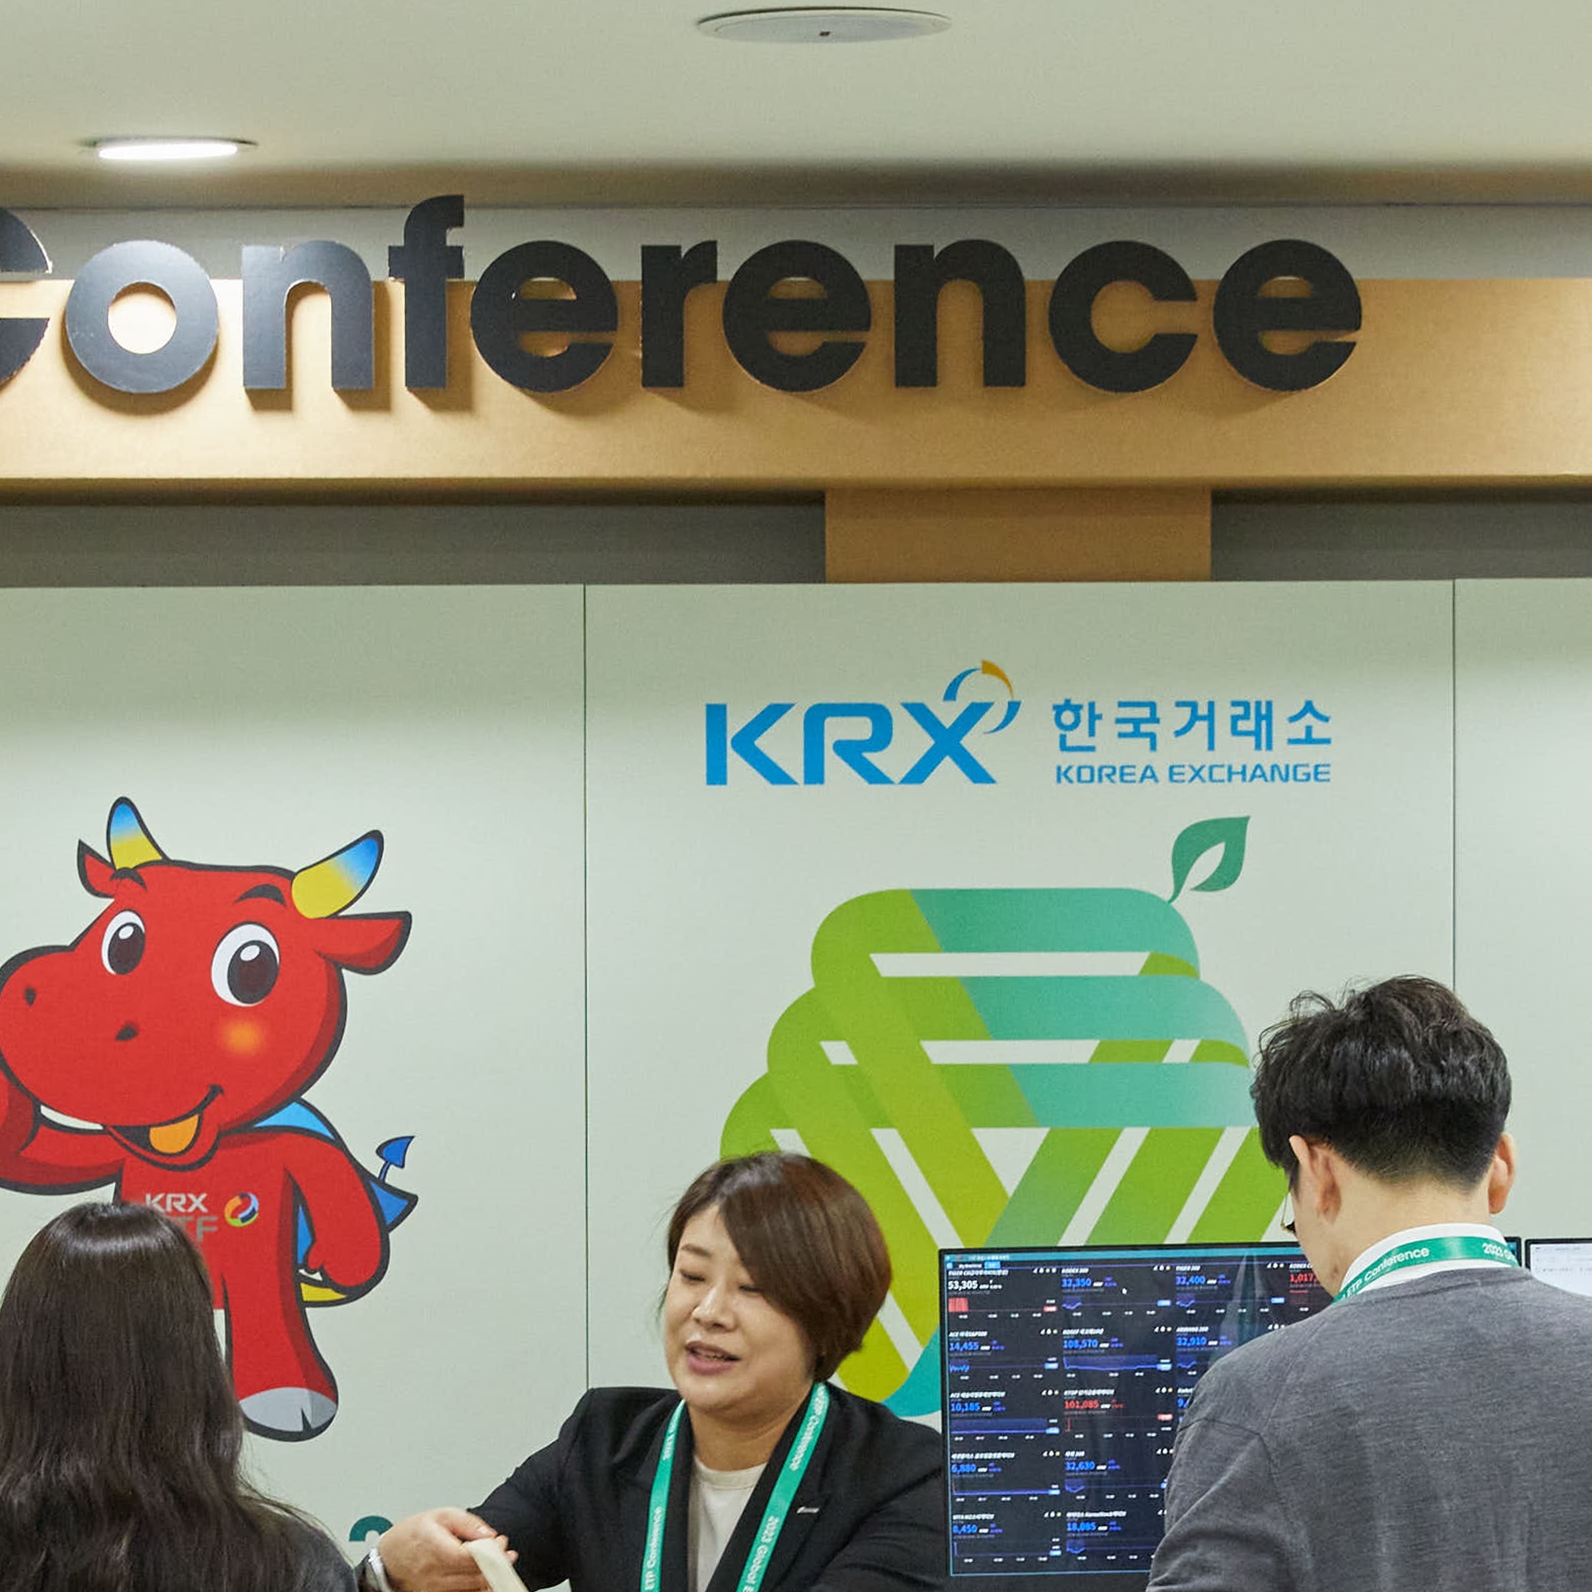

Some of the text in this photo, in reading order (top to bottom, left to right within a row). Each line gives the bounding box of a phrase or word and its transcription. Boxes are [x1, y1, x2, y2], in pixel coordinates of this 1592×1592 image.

[705, 702, 999, 786] KRX
[1052, 698, 1333, 753] 한국거래소
[1056, 763, 1332, 785] KOREA EXCHANGE
[145, 1192, 208, 1213] KRX
[1364, 1246, 1431, 1283] Conference
[646, 1505, 663, 1569] Conference
[761, 1514, 780, 1544] 2023
[745, 1545, 769, 1585] Global
